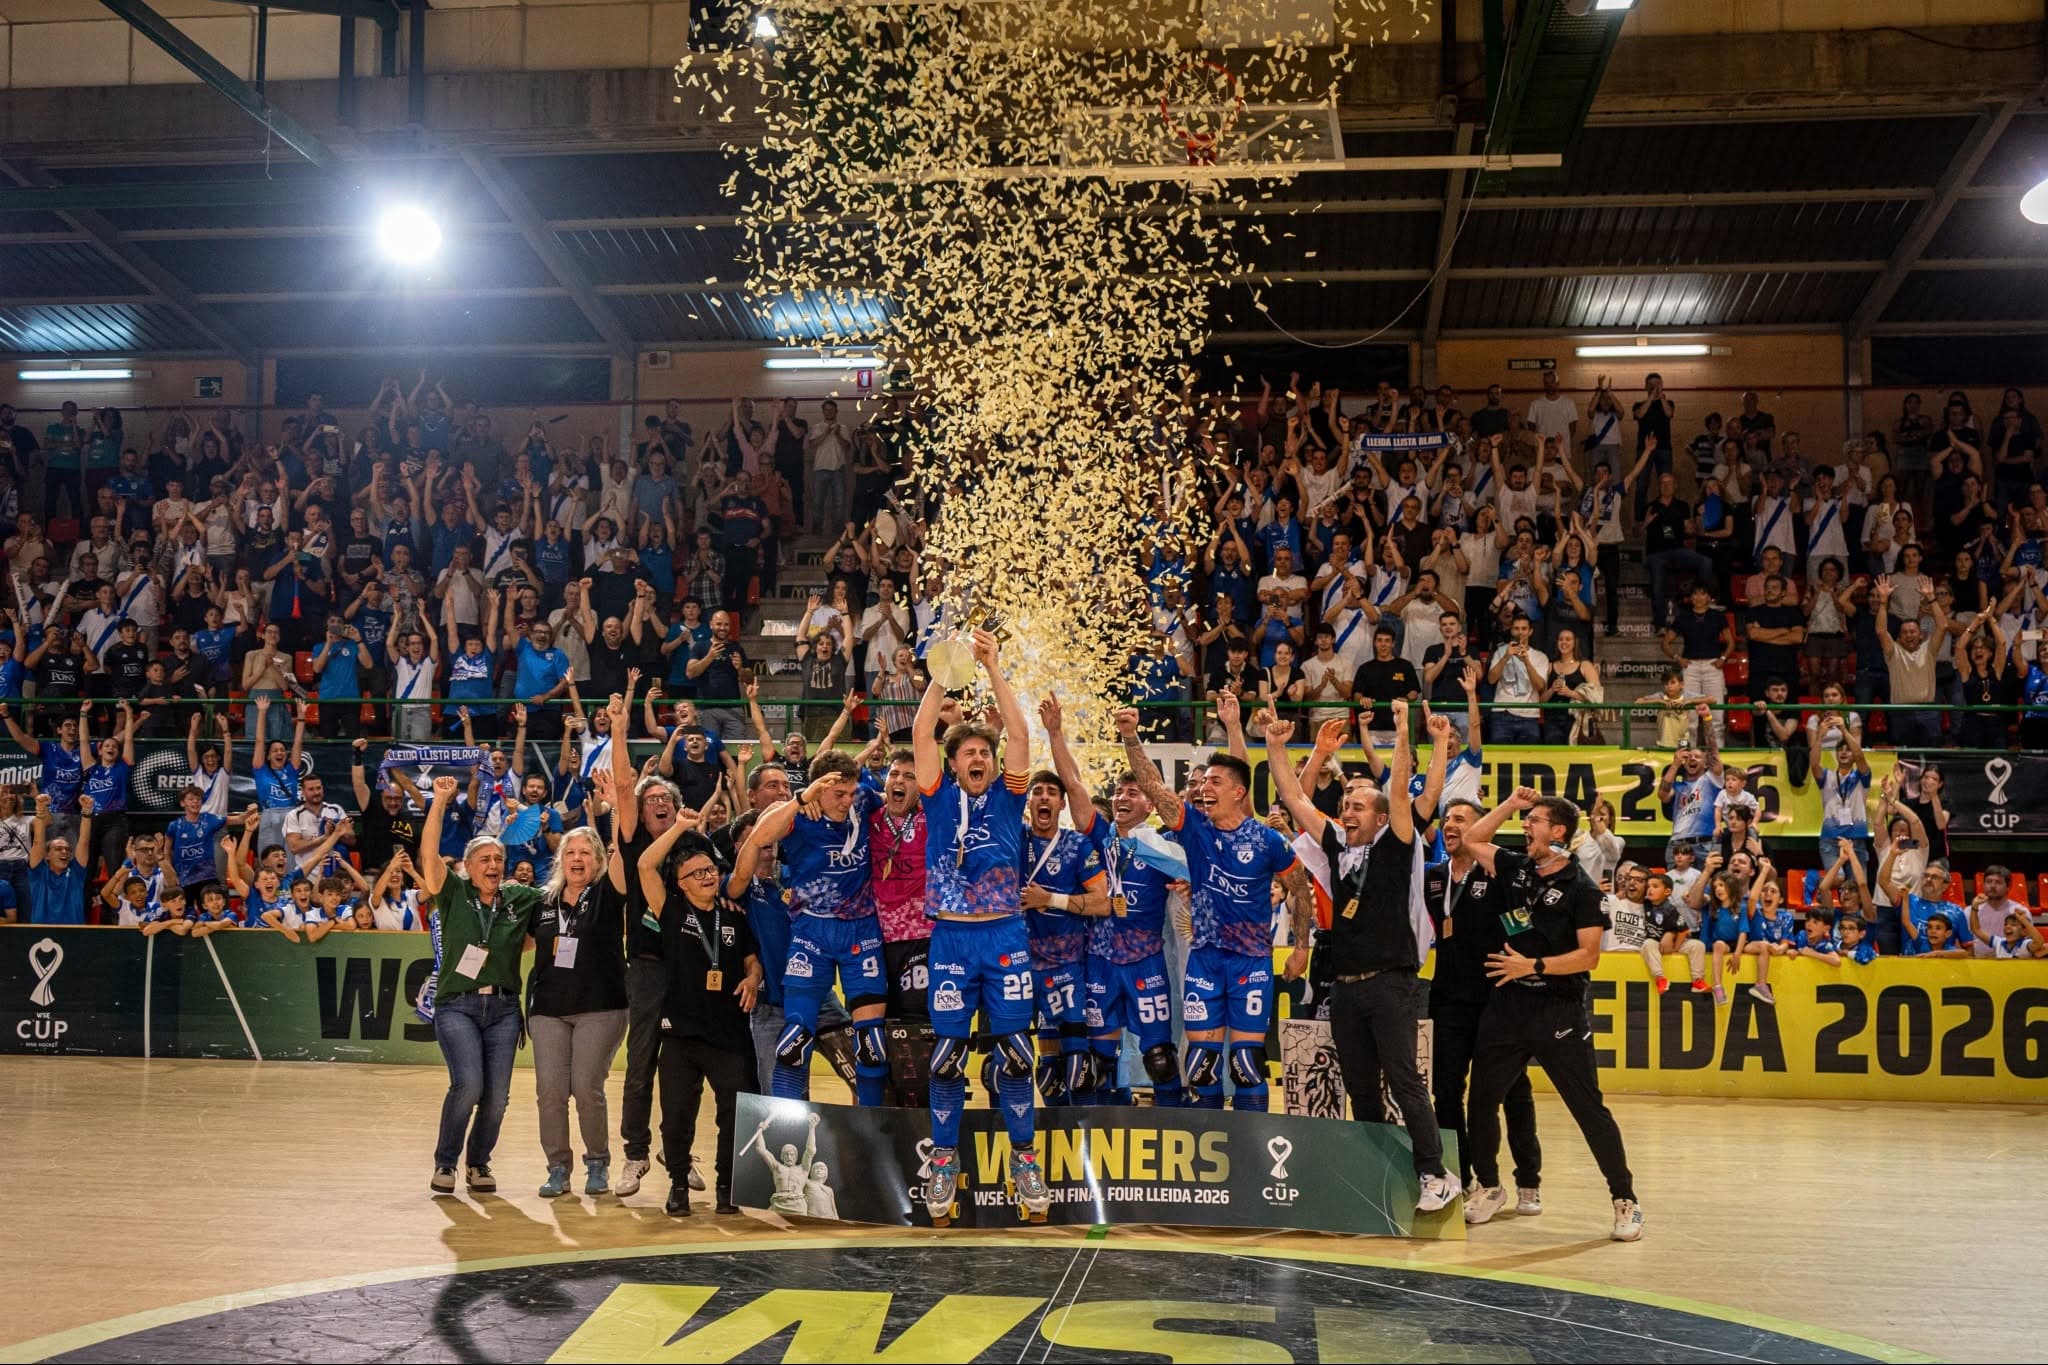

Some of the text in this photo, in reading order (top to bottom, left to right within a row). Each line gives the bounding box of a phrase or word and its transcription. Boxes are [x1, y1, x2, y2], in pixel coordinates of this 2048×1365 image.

[420, 749, 450, 761] LLISTA
[452, 748, 480, 760] BLAVA
[1979, 813, 2020, 828] CUP
[862, 955, 880, 978] 9
[1003, 971, 1033, 1000] 22
[1047, 984, 1075, 1016] 27
[1138, 994, 1170, 1023] 55
[1246, 989, 1263, 1016] 6
[16, 1019, 69, 1040] CUP
[892, 1029, 908, 1039] 60
[1815, 984, 2048, 1079] 2026
[974, 1128, 1231, 1184] WINNERS
[974, 1190, 1004, 1206] WSE
[1067, 1187, 1104, 1202] FINAL
[1108, 1186, 1143, 1202] FOUR
[1146, 1186, 1192, 1203] LLEIDA
[1194, 1188, 1230, 1204] 2026
[1262, 1187, 1300, 1201] CUP
